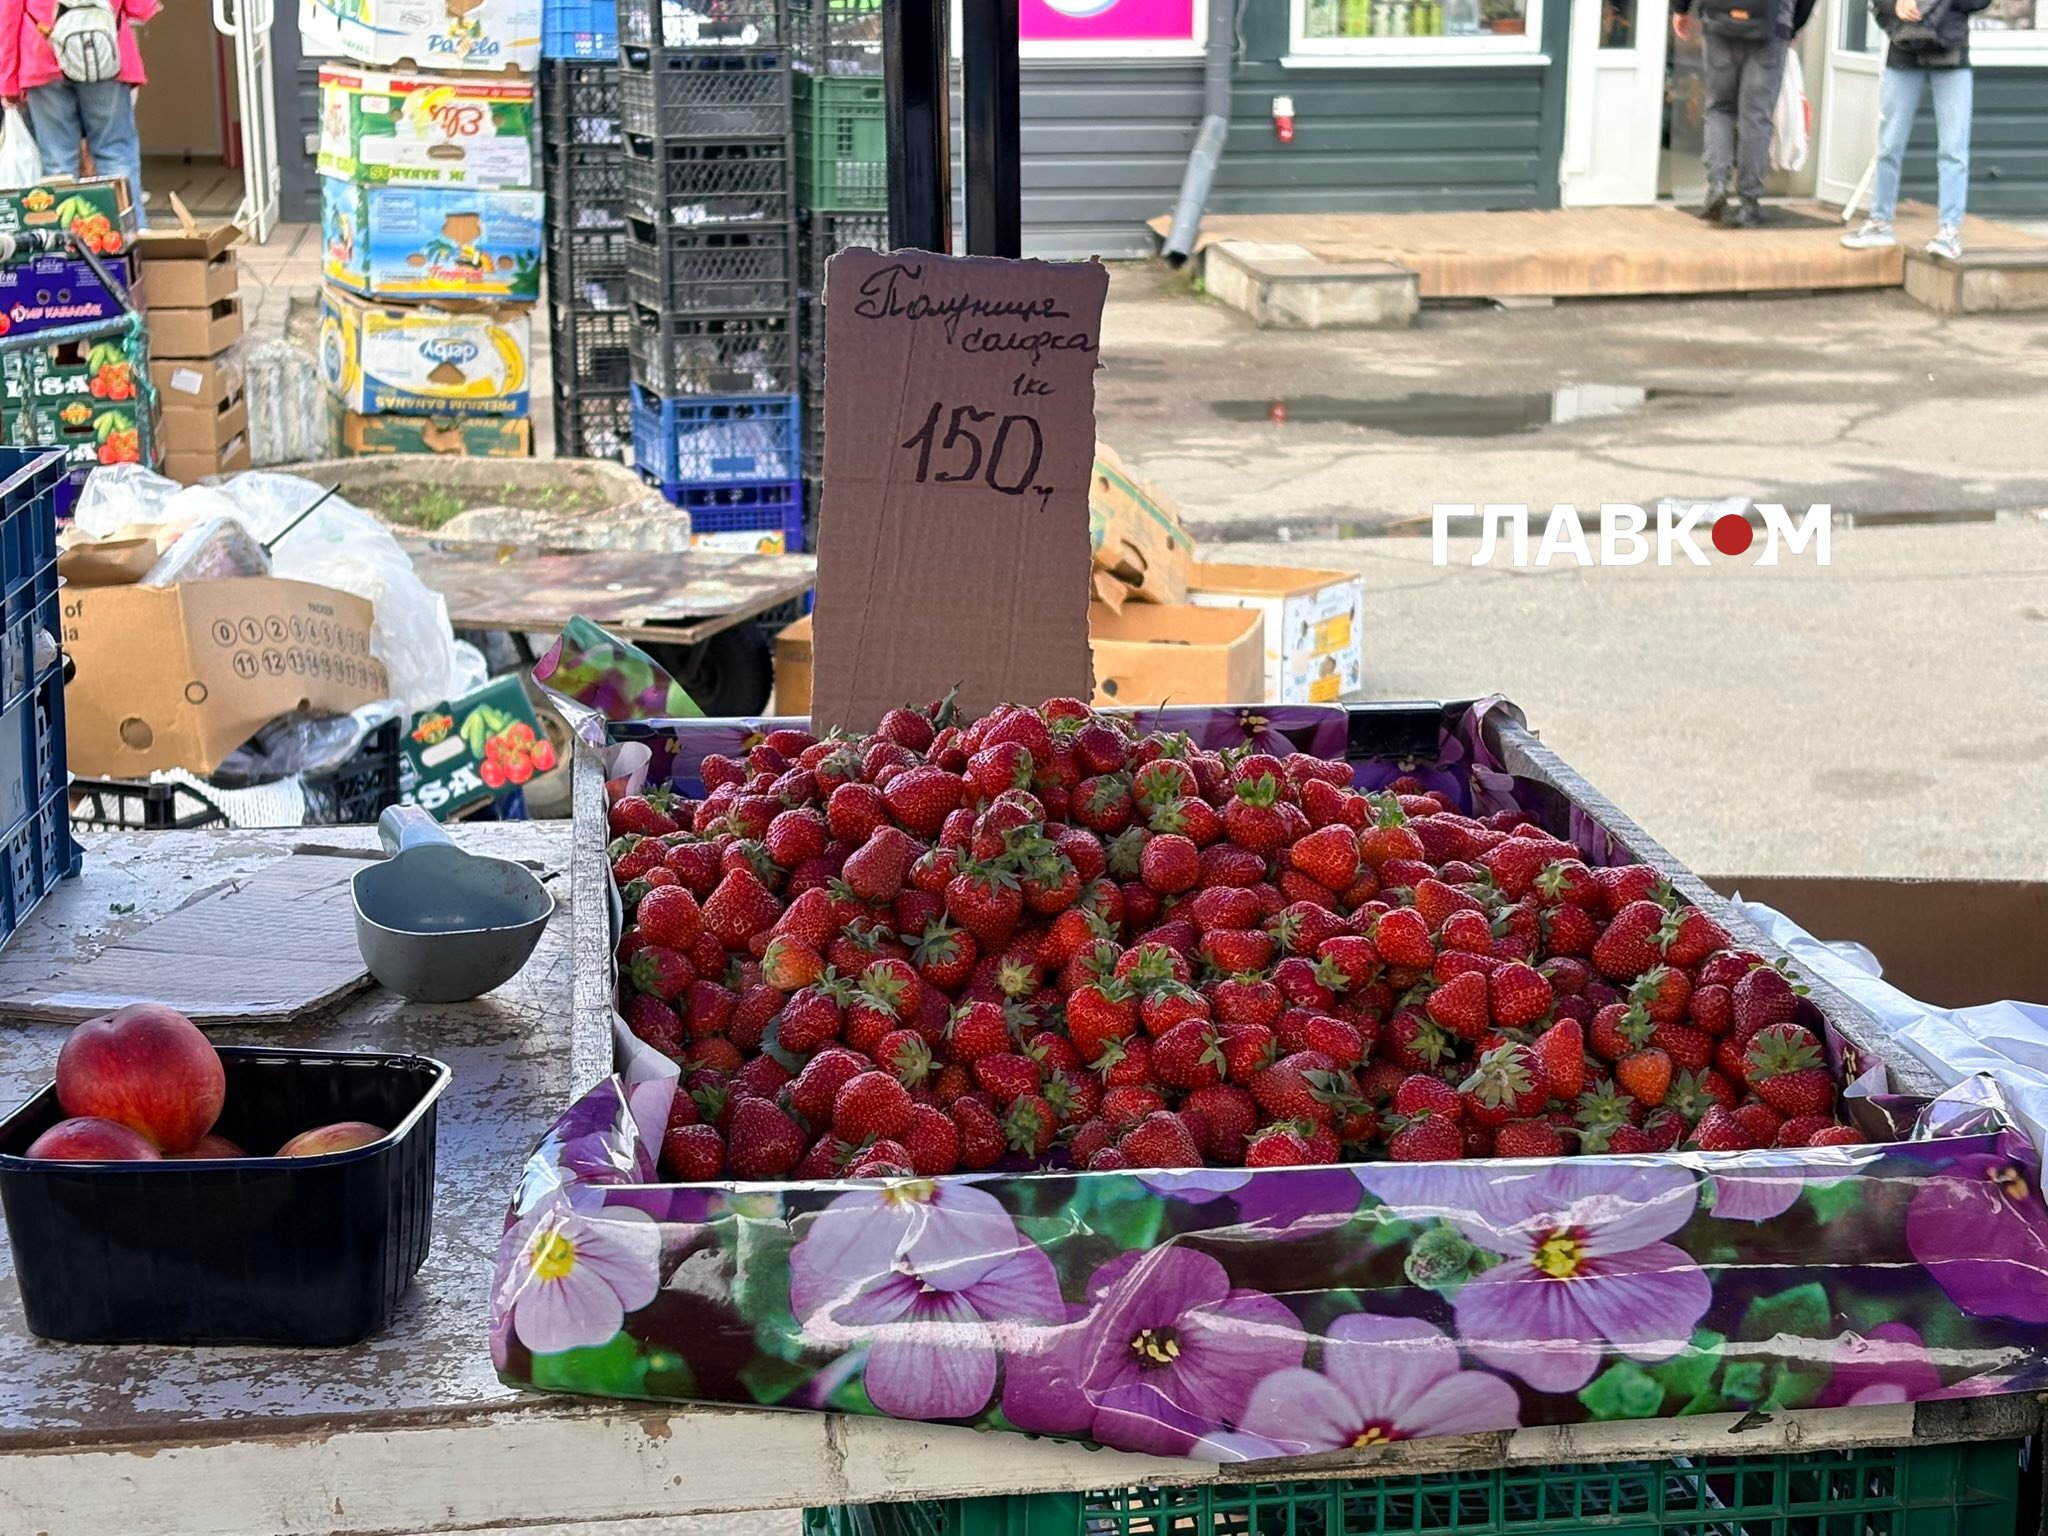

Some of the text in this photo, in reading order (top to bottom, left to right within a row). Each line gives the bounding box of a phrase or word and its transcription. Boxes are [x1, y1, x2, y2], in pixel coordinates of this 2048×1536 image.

[427, 34, 500, 56] Paela
[430, 105, 482, 138] Elis
[370, 166, 441, 181] BANANAS
[423, 339, 475, 363] derby
[375, 396, 517, 411] PREMIUM BANANAS
[902, 402, 1044, 495] 150
